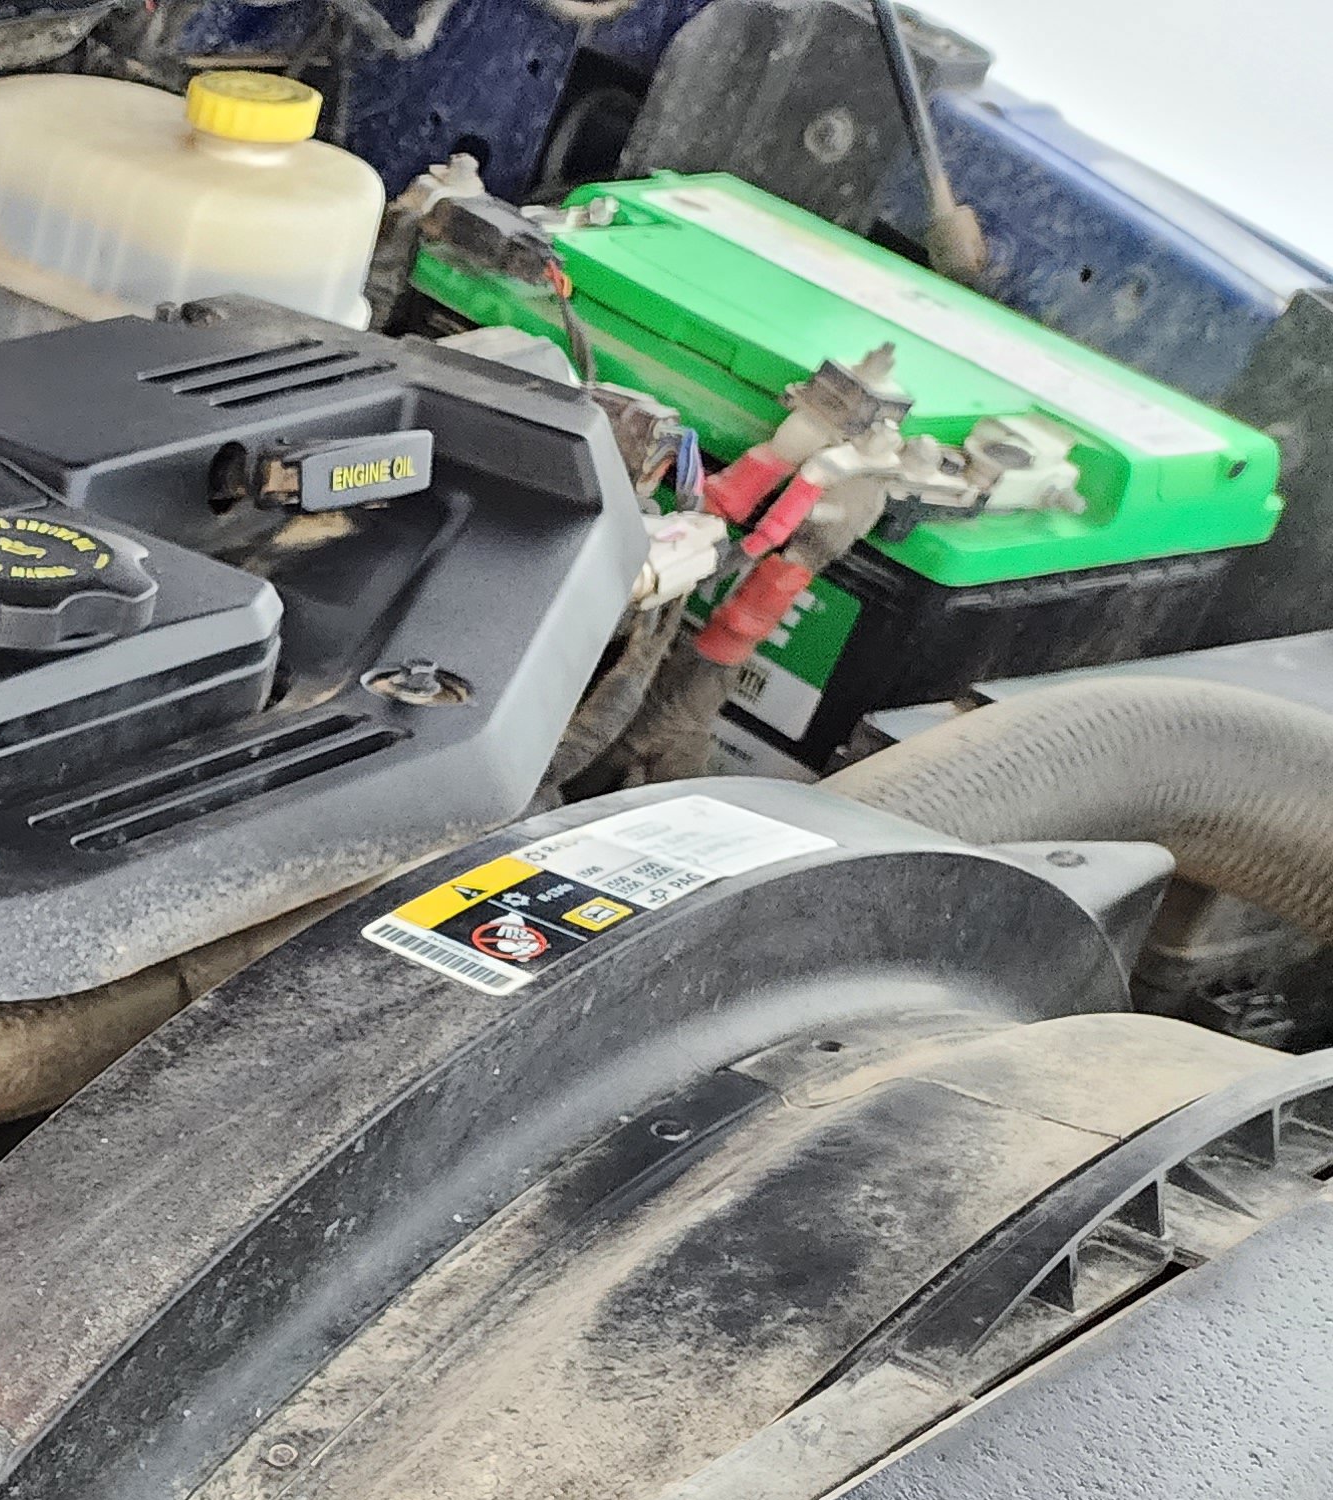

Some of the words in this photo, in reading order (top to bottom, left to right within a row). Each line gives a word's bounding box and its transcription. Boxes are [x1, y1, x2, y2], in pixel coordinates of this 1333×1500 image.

[332, 458, 391, 492] ENGINE
[392, 456, 417, 480] OIL
[668, 872, 706, 890] PAG
